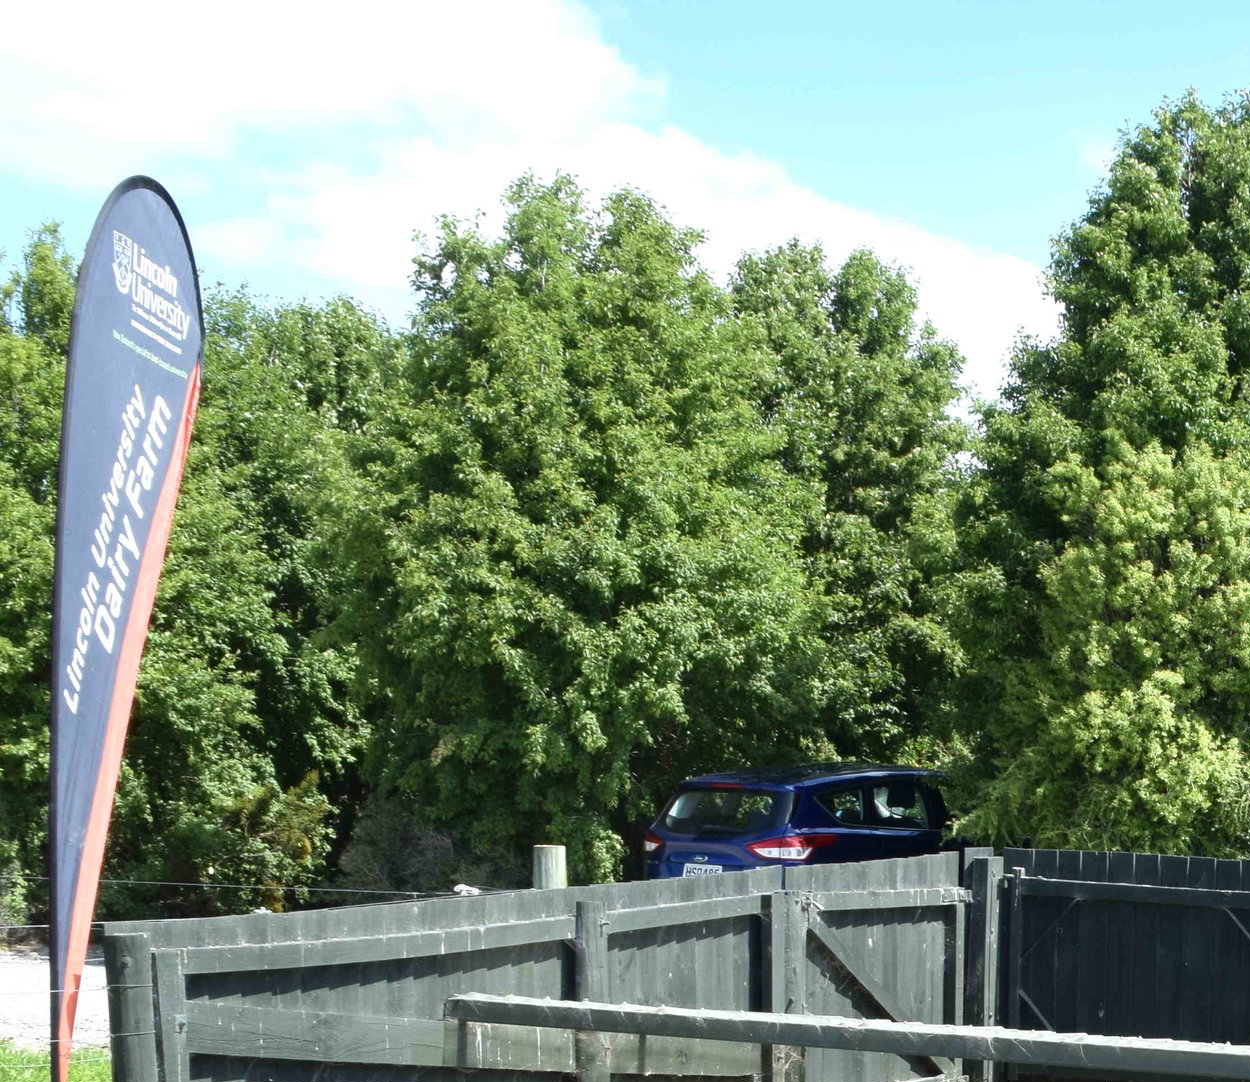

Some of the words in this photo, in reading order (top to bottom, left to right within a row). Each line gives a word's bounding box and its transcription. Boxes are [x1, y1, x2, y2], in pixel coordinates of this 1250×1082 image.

[131, 271, 191, 340] University
[133, 242, 178, 298] Lincoln
[63, 571, 101, 715] Lincoln
[91, 383, 146, 568] University
[95, 515, 141, 655] Dairy
[124, 394, 172, 519] Farm
